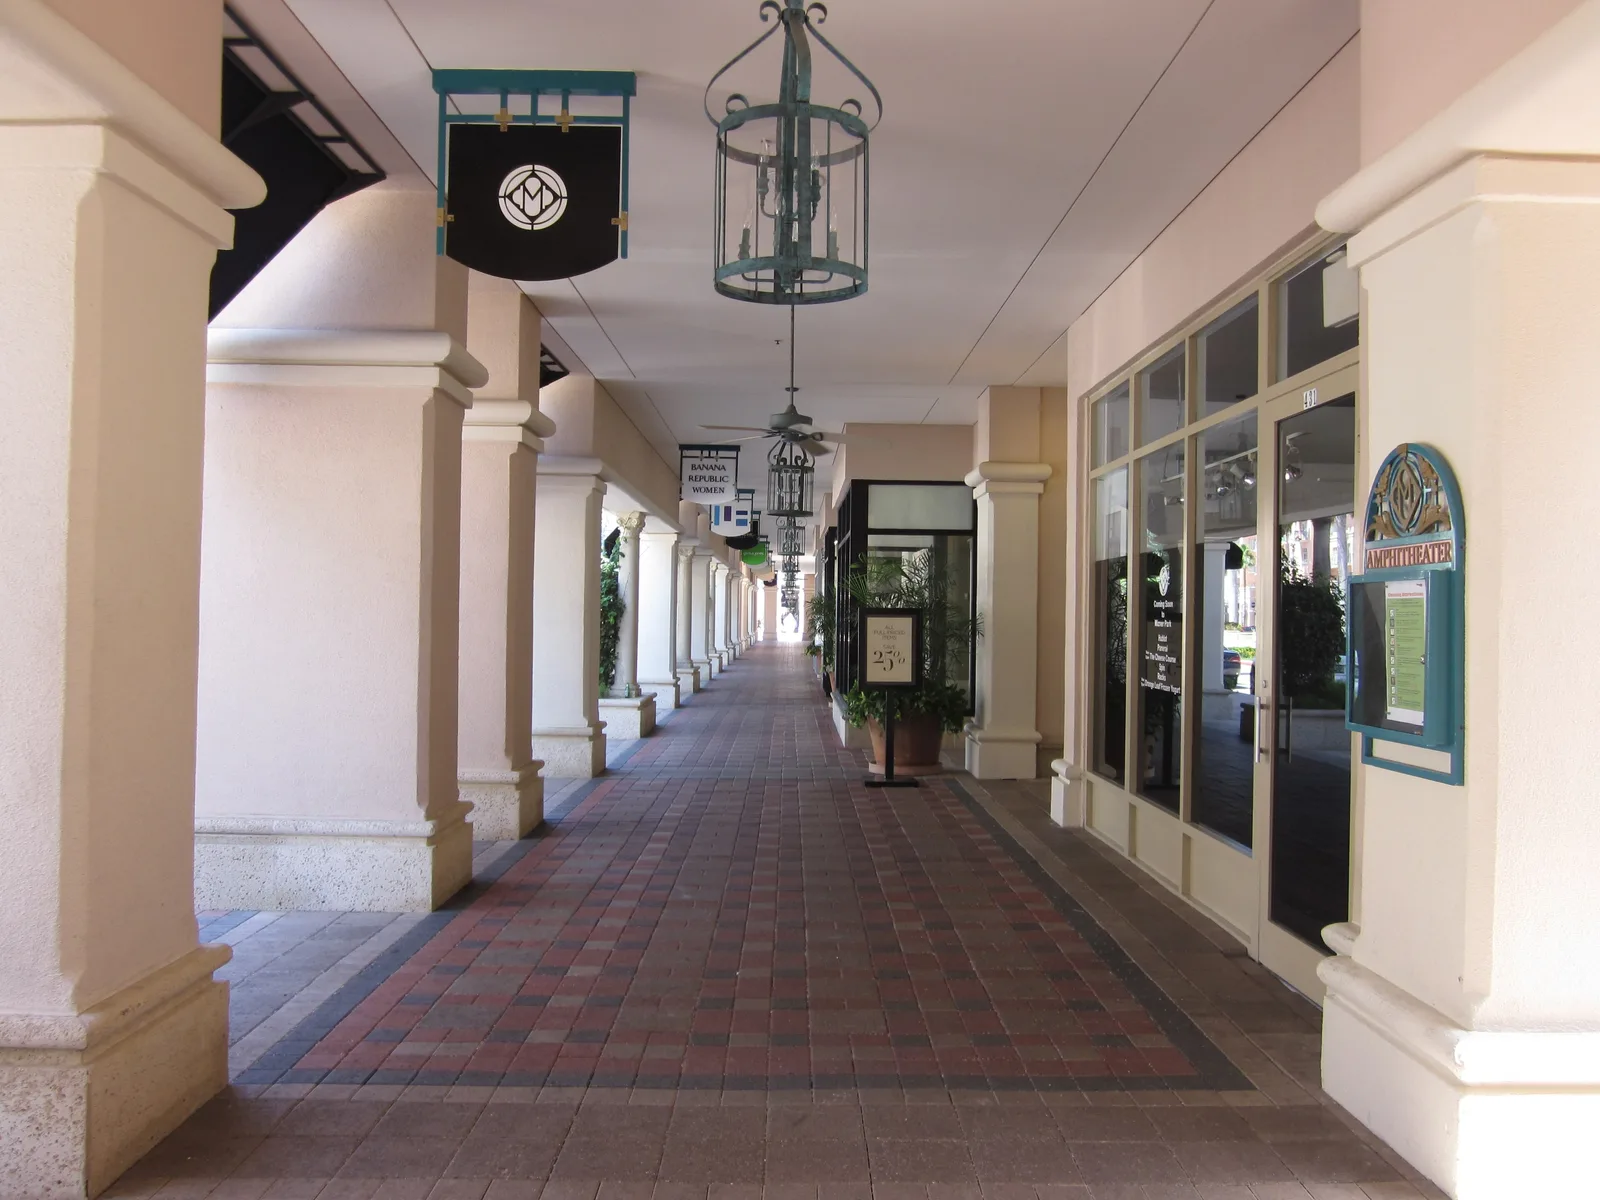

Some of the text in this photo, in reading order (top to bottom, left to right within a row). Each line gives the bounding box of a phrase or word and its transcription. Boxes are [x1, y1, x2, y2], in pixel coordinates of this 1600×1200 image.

[1304, 389, 1316, 408] 431
[691, 463, 726, 472] BANANA
[688, 475, 729, 483] REPUBLIC
[1367, 542, 1452, 569] AMPHITHEATER
[1153, 600, 1164, 609] Coming
